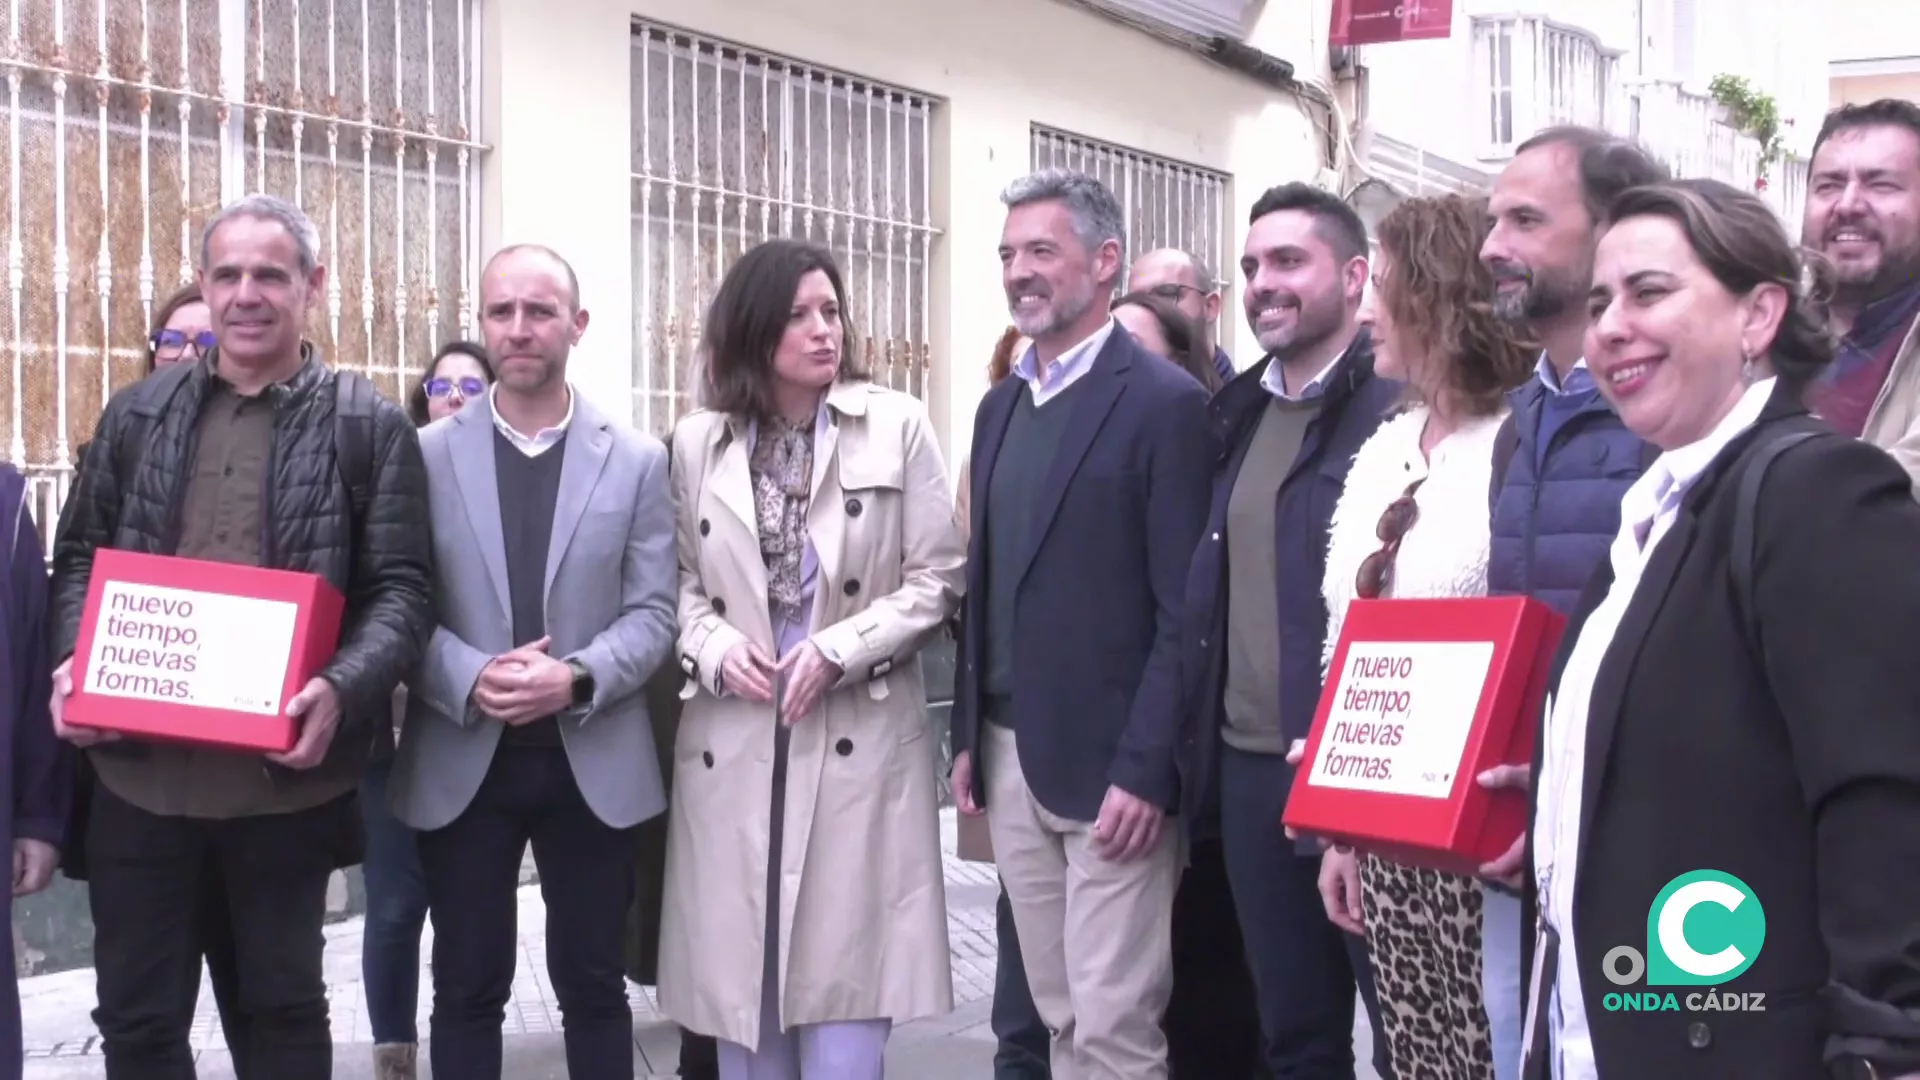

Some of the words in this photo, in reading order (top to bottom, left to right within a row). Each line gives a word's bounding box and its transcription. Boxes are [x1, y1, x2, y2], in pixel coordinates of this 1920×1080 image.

[111, 592, 193, 618] nuevo
[107, 613, 201, 651] tiempo,
[101, 644, 197, 672] nuevas
[1352, 656, 1413, 679] nuevo
[96, 665, 194, 700] formas.
[1343, 681, 1411, 720] tiempo,
[1332, 720, 1404, 746] nuevas
[1322, 746, 1393, 779] formas.
